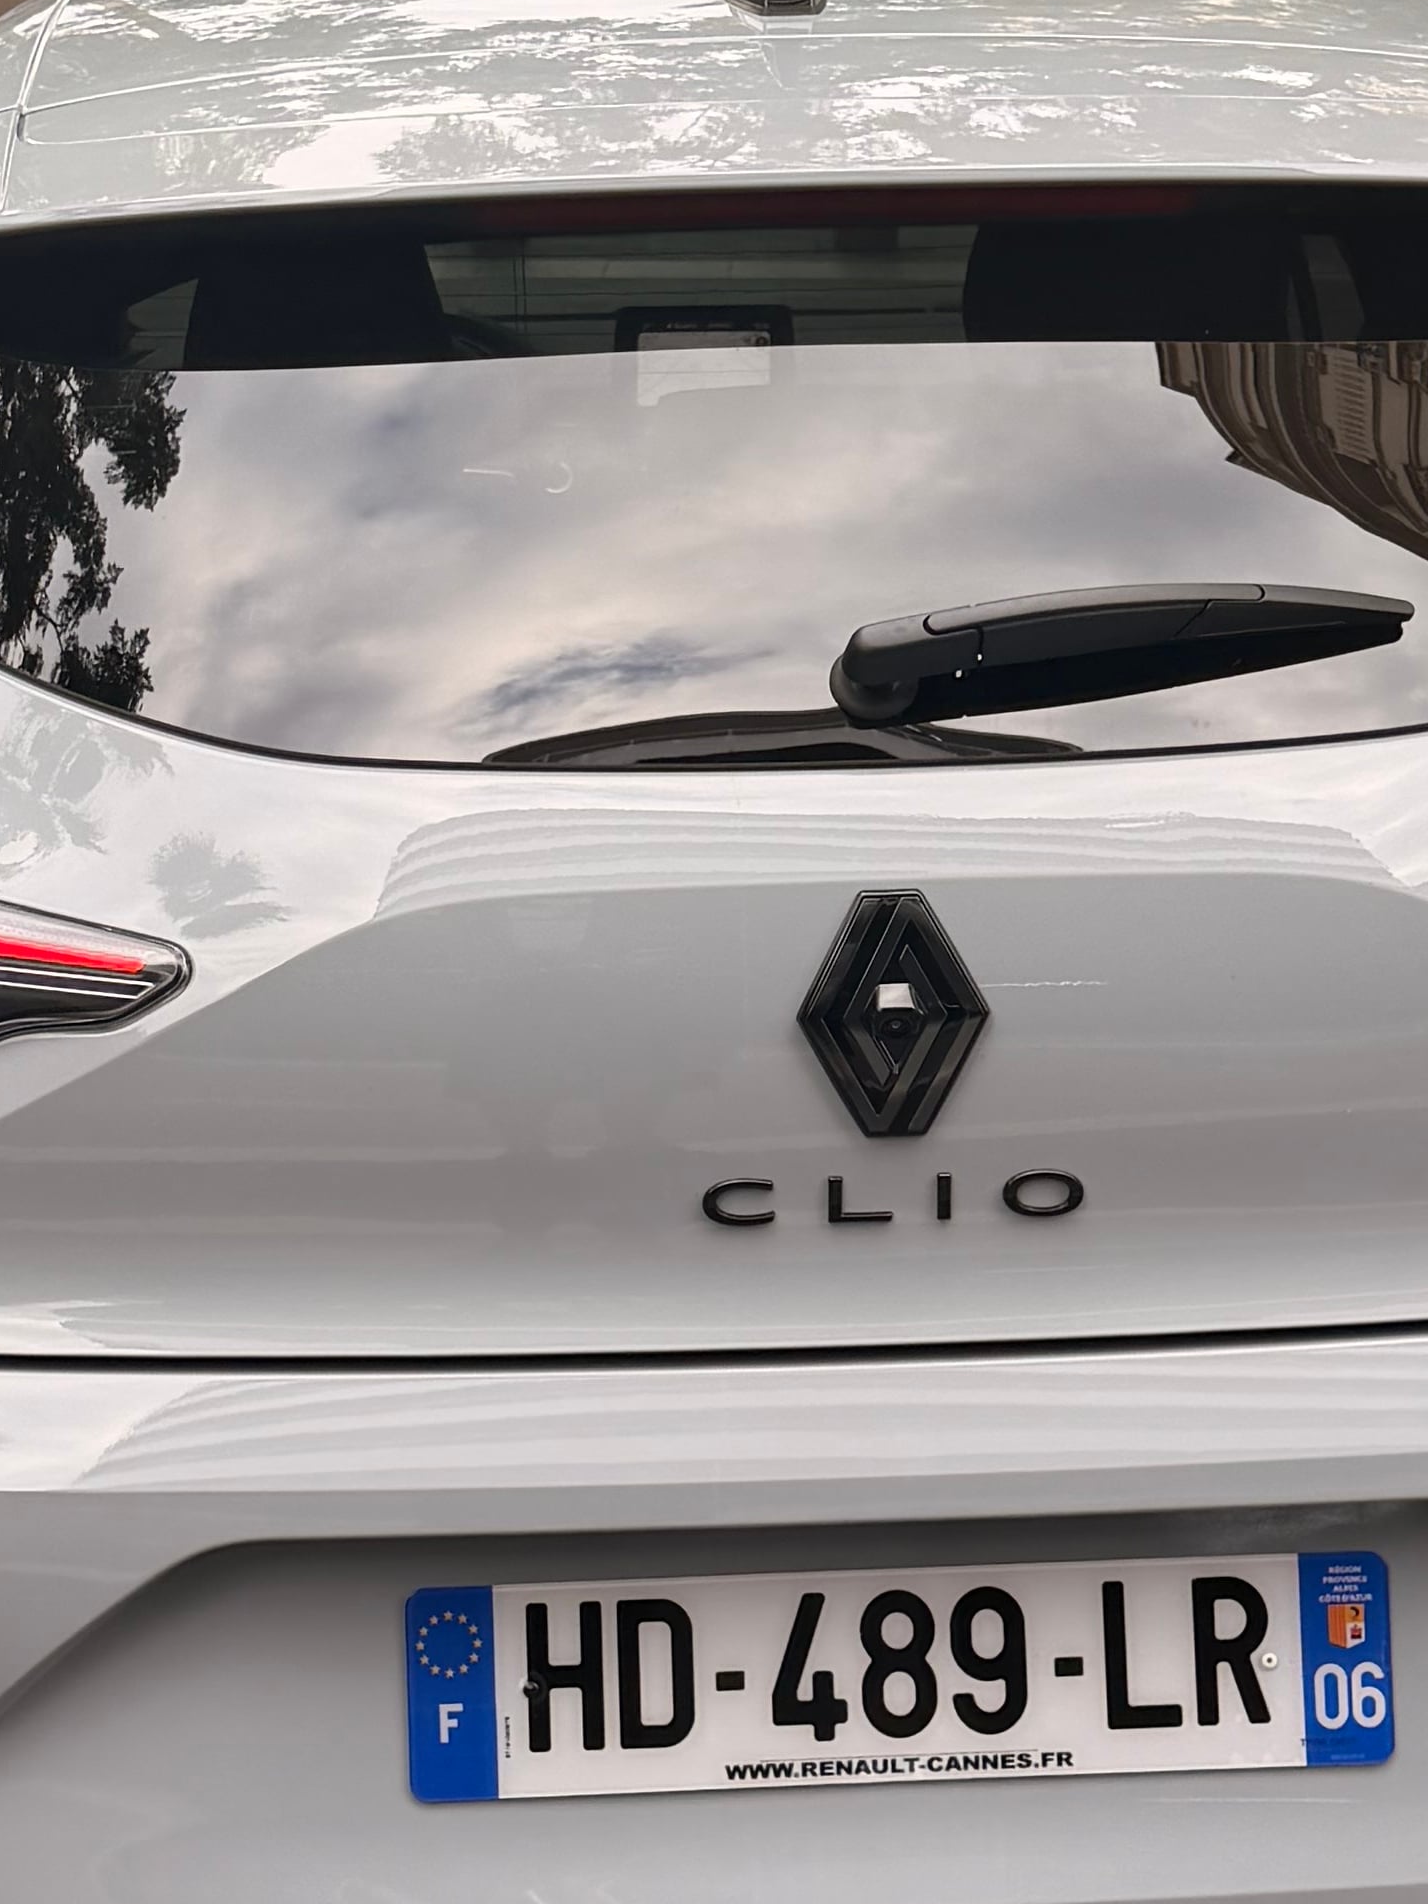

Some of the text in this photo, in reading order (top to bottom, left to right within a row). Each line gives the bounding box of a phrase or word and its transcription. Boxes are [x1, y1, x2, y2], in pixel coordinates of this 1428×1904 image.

[701, 1168, 1085, 1231] CLIO
[523, 1575, 1271, 1753] HD-489-LR
[438, 1703, 464, 1744] F
[1314, 1662, 1387, 1730] 06
[724, 1751, 1074, 1780] WWW.RENAULT-CANNES.FR
